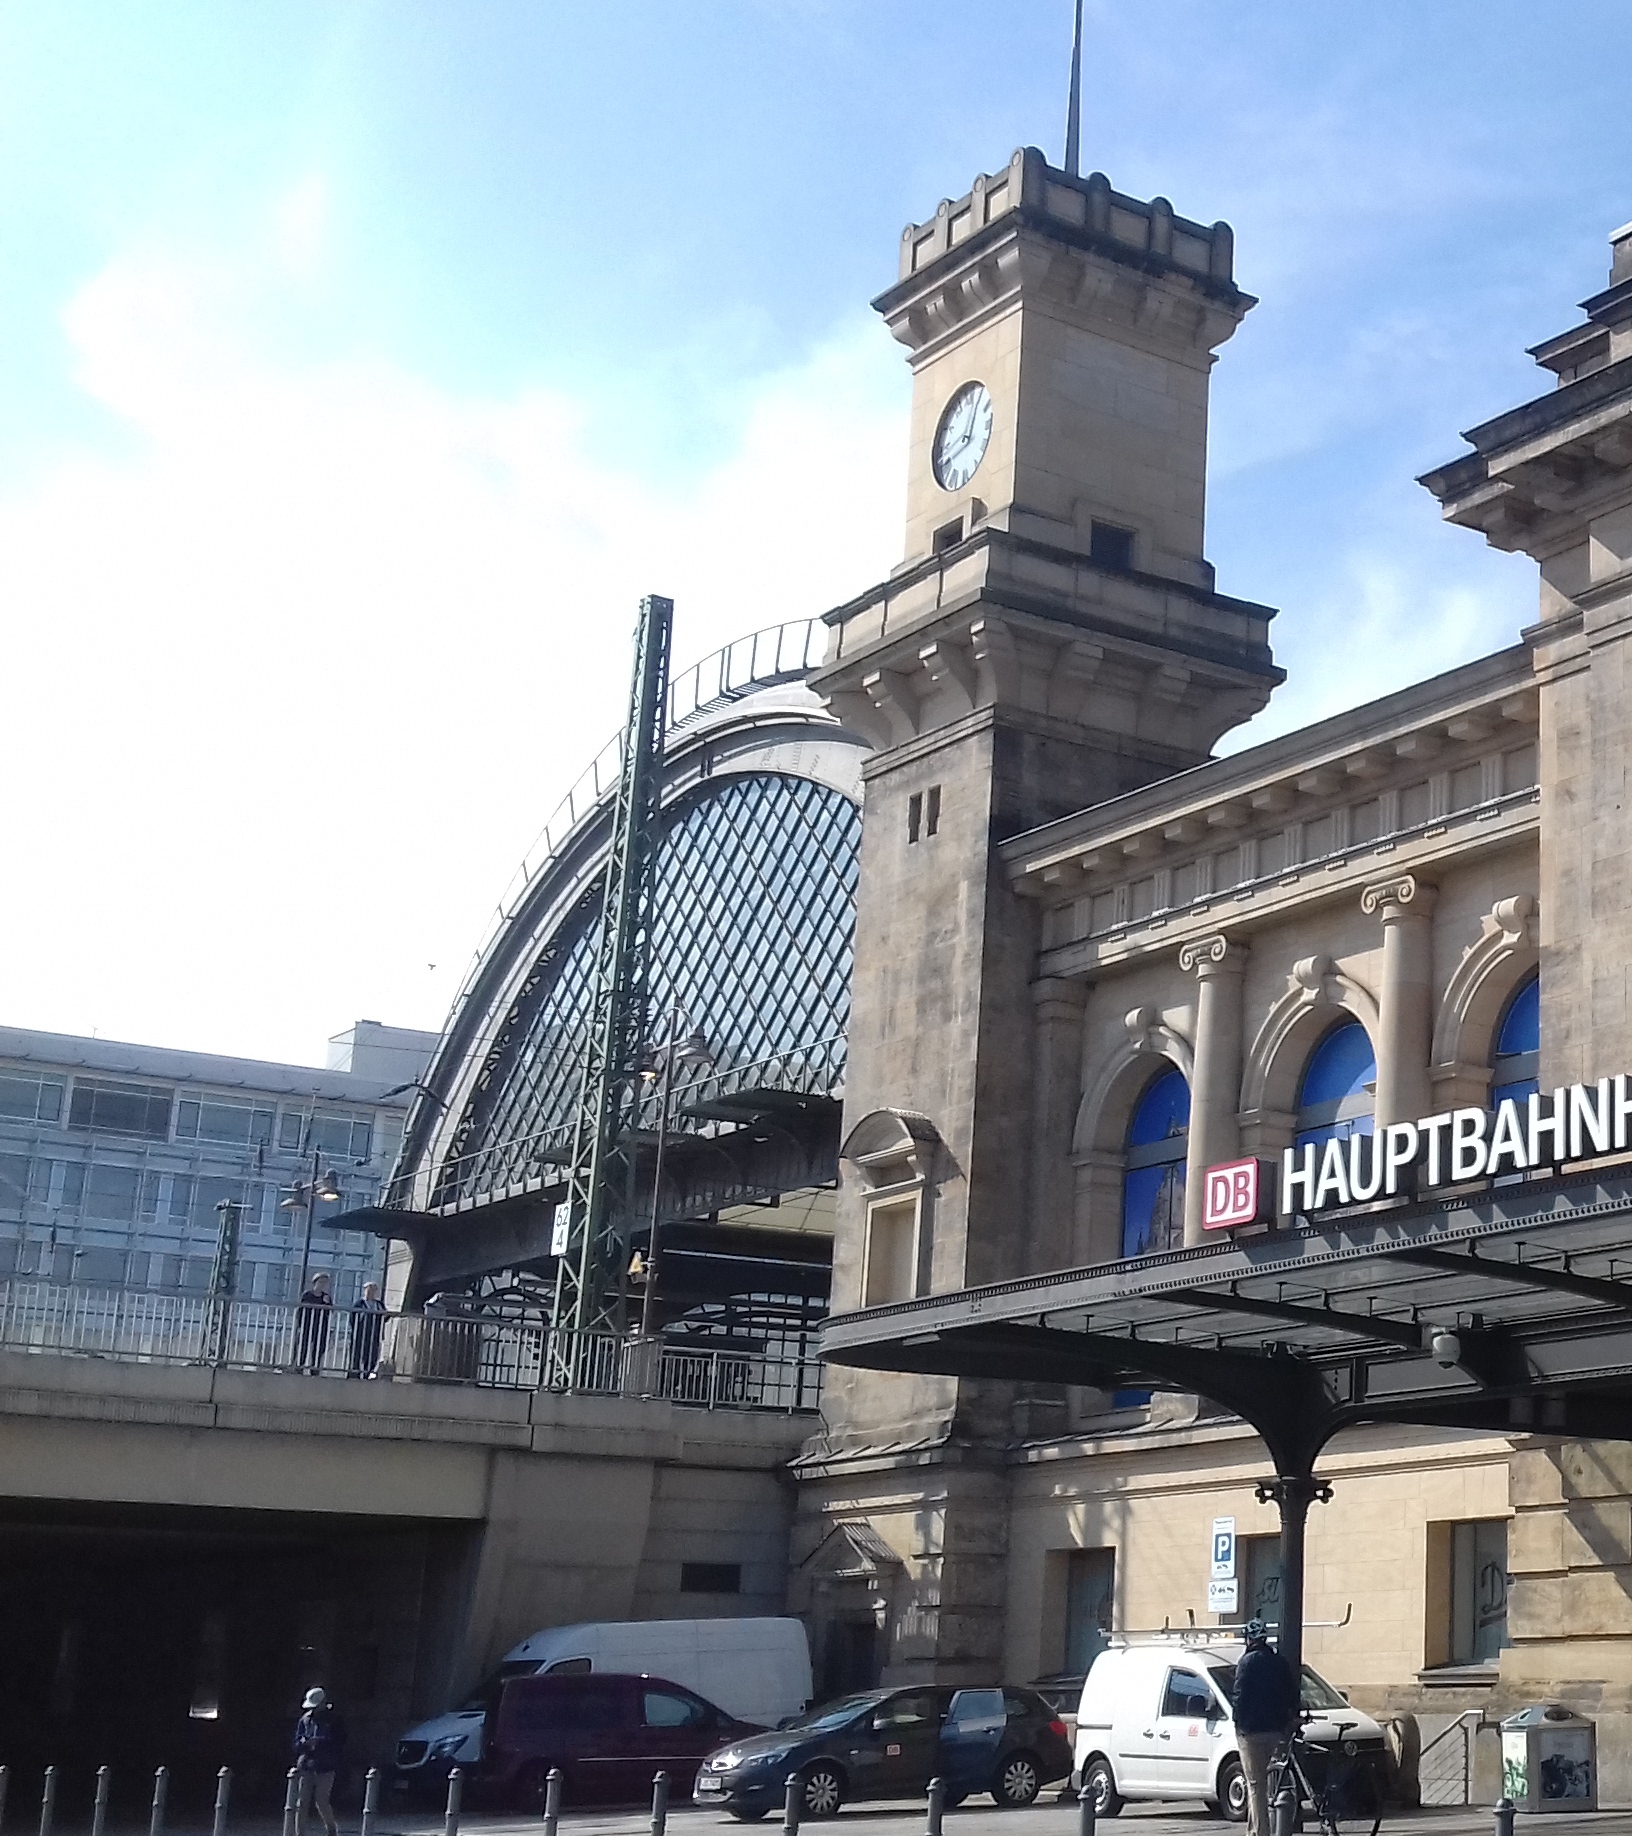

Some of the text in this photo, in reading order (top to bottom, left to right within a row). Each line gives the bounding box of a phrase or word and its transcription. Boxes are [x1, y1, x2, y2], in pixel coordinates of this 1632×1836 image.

[1210, 1170, 1251, 1218] DB
[556, 1205, 569, 1227] 62
[556, 1229, 564, 1248] 4
[1217, 1535, 1230, 1560] P
